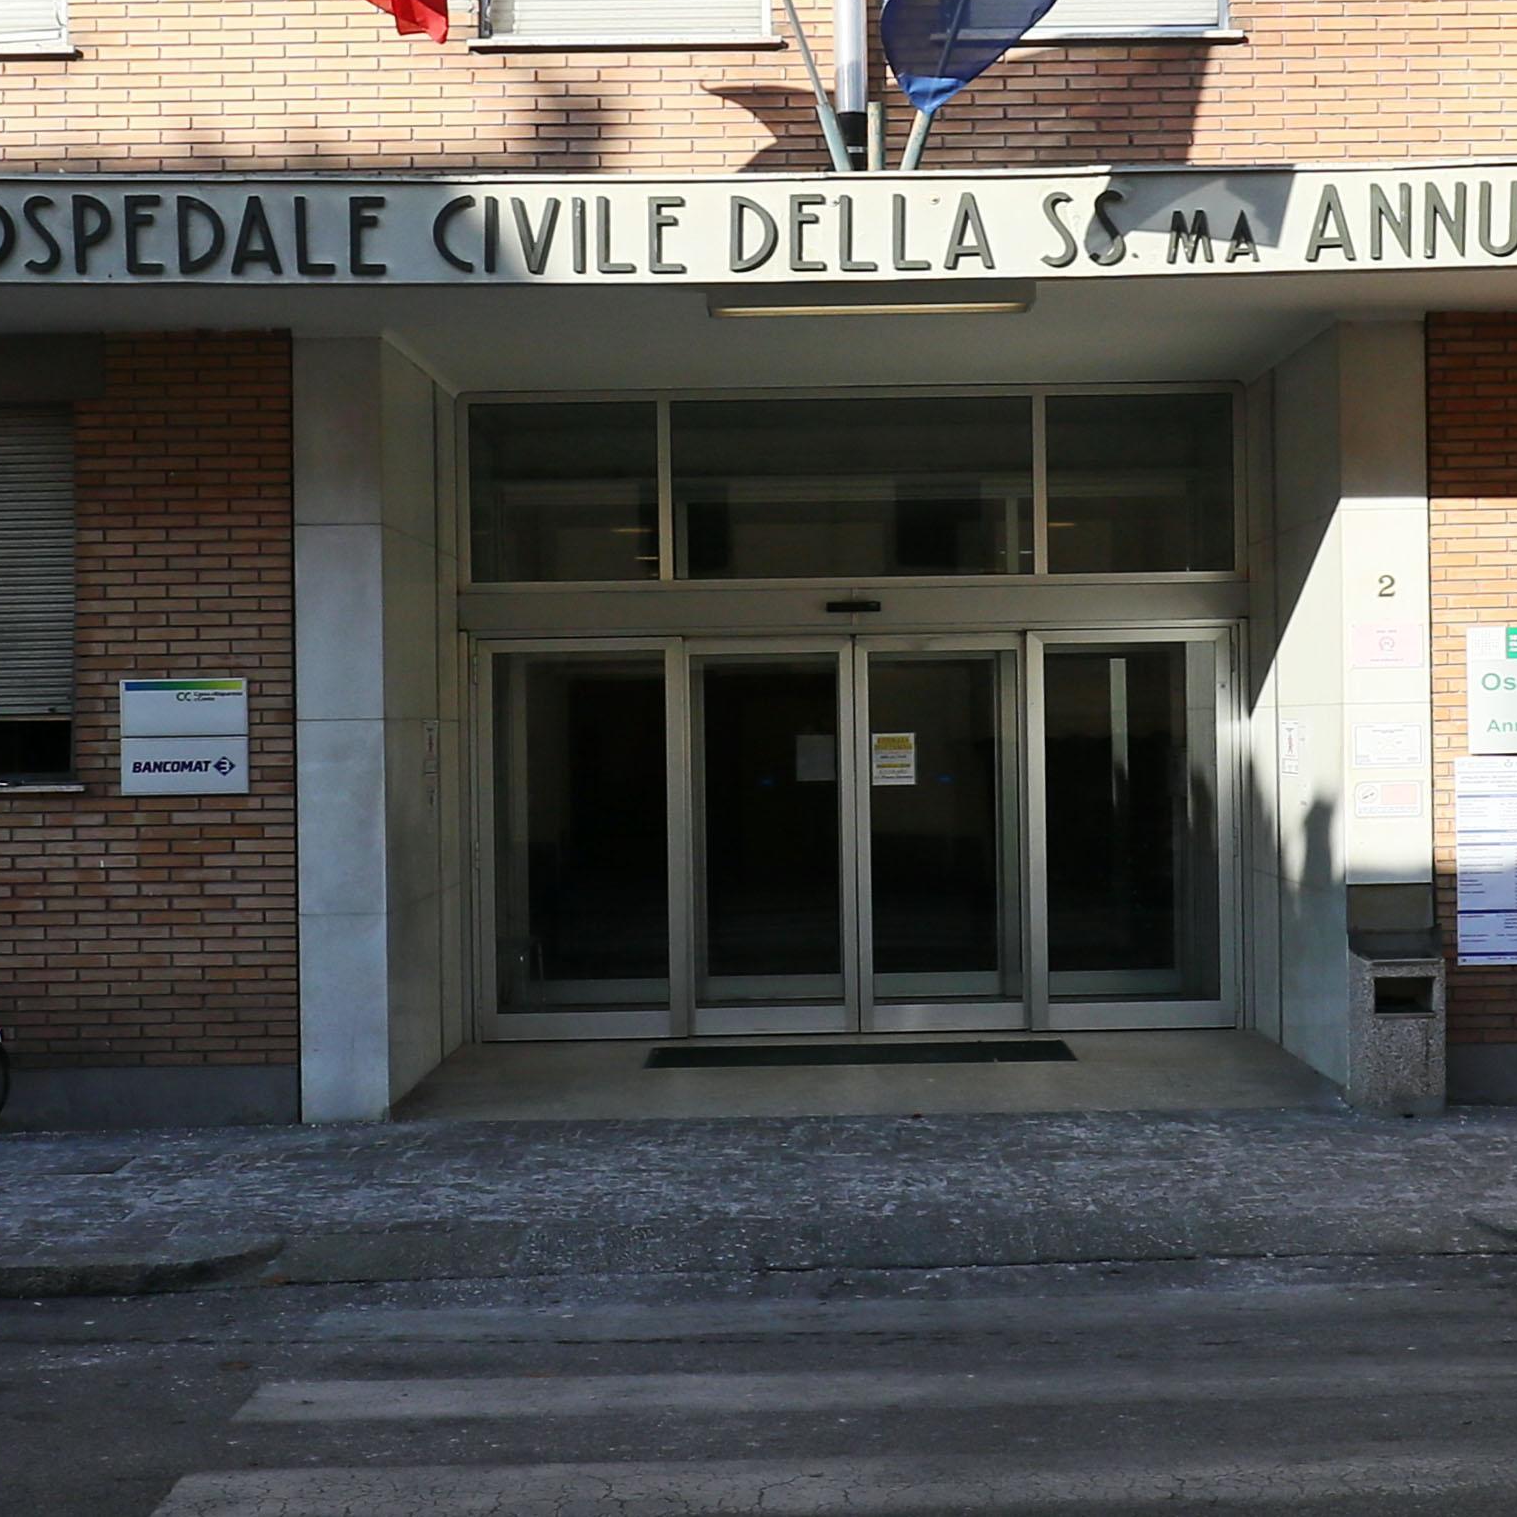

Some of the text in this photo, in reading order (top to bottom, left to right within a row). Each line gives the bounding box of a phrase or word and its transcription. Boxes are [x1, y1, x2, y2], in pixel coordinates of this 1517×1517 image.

[432, 193, 689, 274] CIVILE
[729, 193, 997, 272] DELLA
[1377, 574, 1396, 597] 2
[132, 760, 212, 774] BANCOMAT
